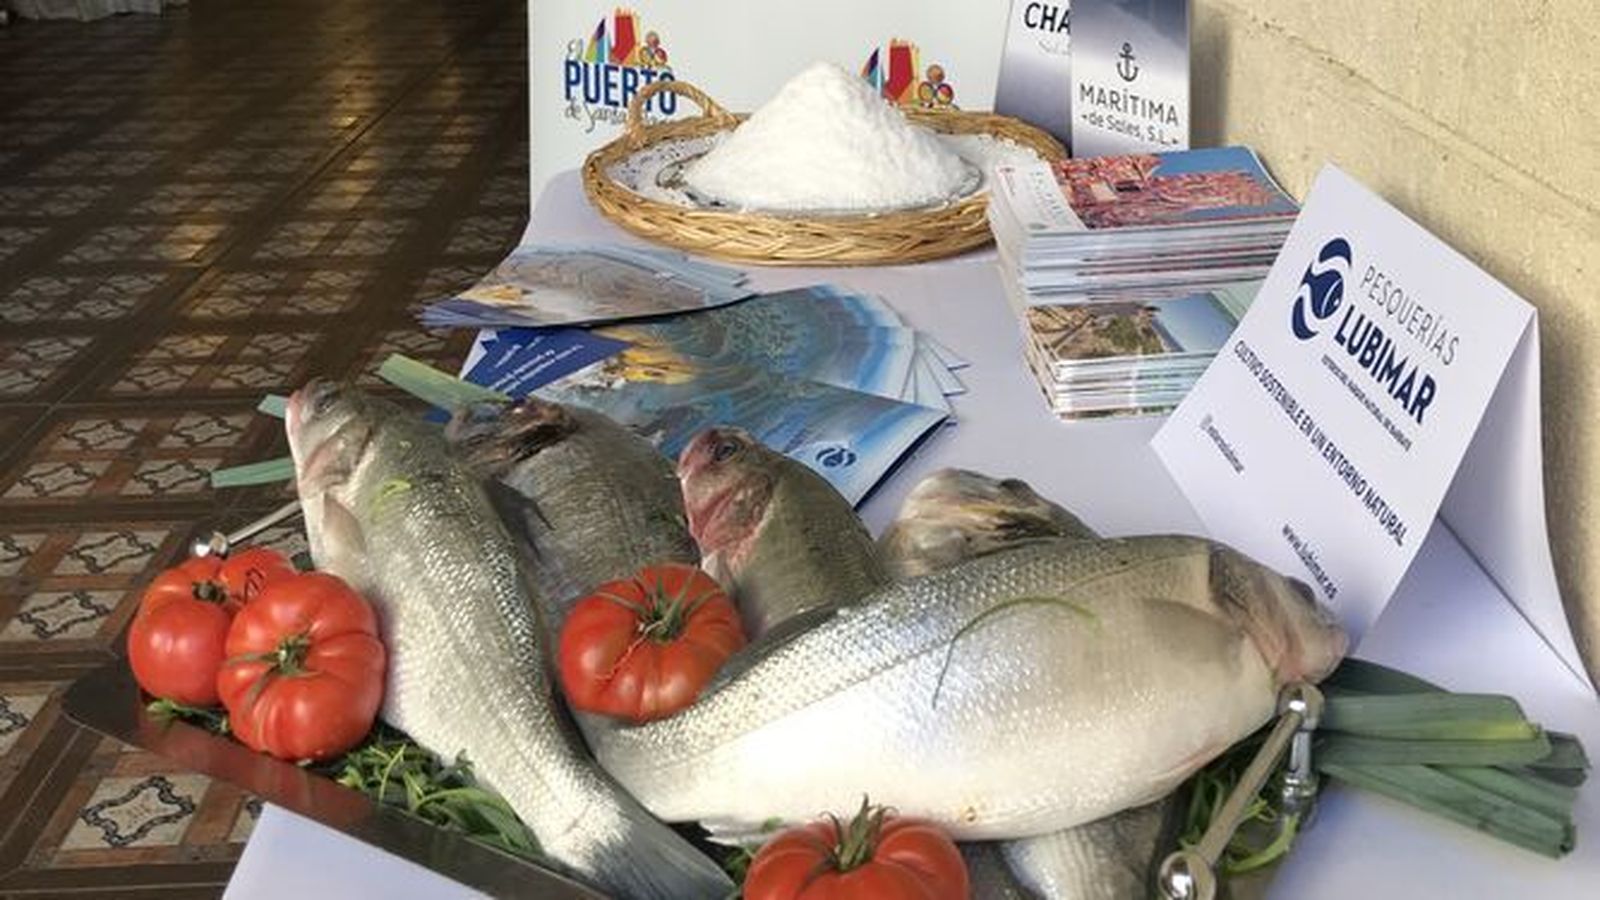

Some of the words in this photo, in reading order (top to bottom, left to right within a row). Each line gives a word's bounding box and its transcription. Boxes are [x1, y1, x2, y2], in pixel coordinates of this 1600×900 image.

[564, 60, 677, 115] PUERTO
[1334, 304, 1436, 424] LUBIMAR
[1360, 265, 1460, 366] PESQUERÍAS
[1234, 340, 1264, 376] CULTIVO
[1259, 369, 1304, 425] SOSTENIBLE
[1300, 413, 1315, 437] EN
[1311, 427, 1327, 452] UN
[1322, 441, 1366, 496] ENTORNO
[1362, 484, 1409, 547] NATURAL
